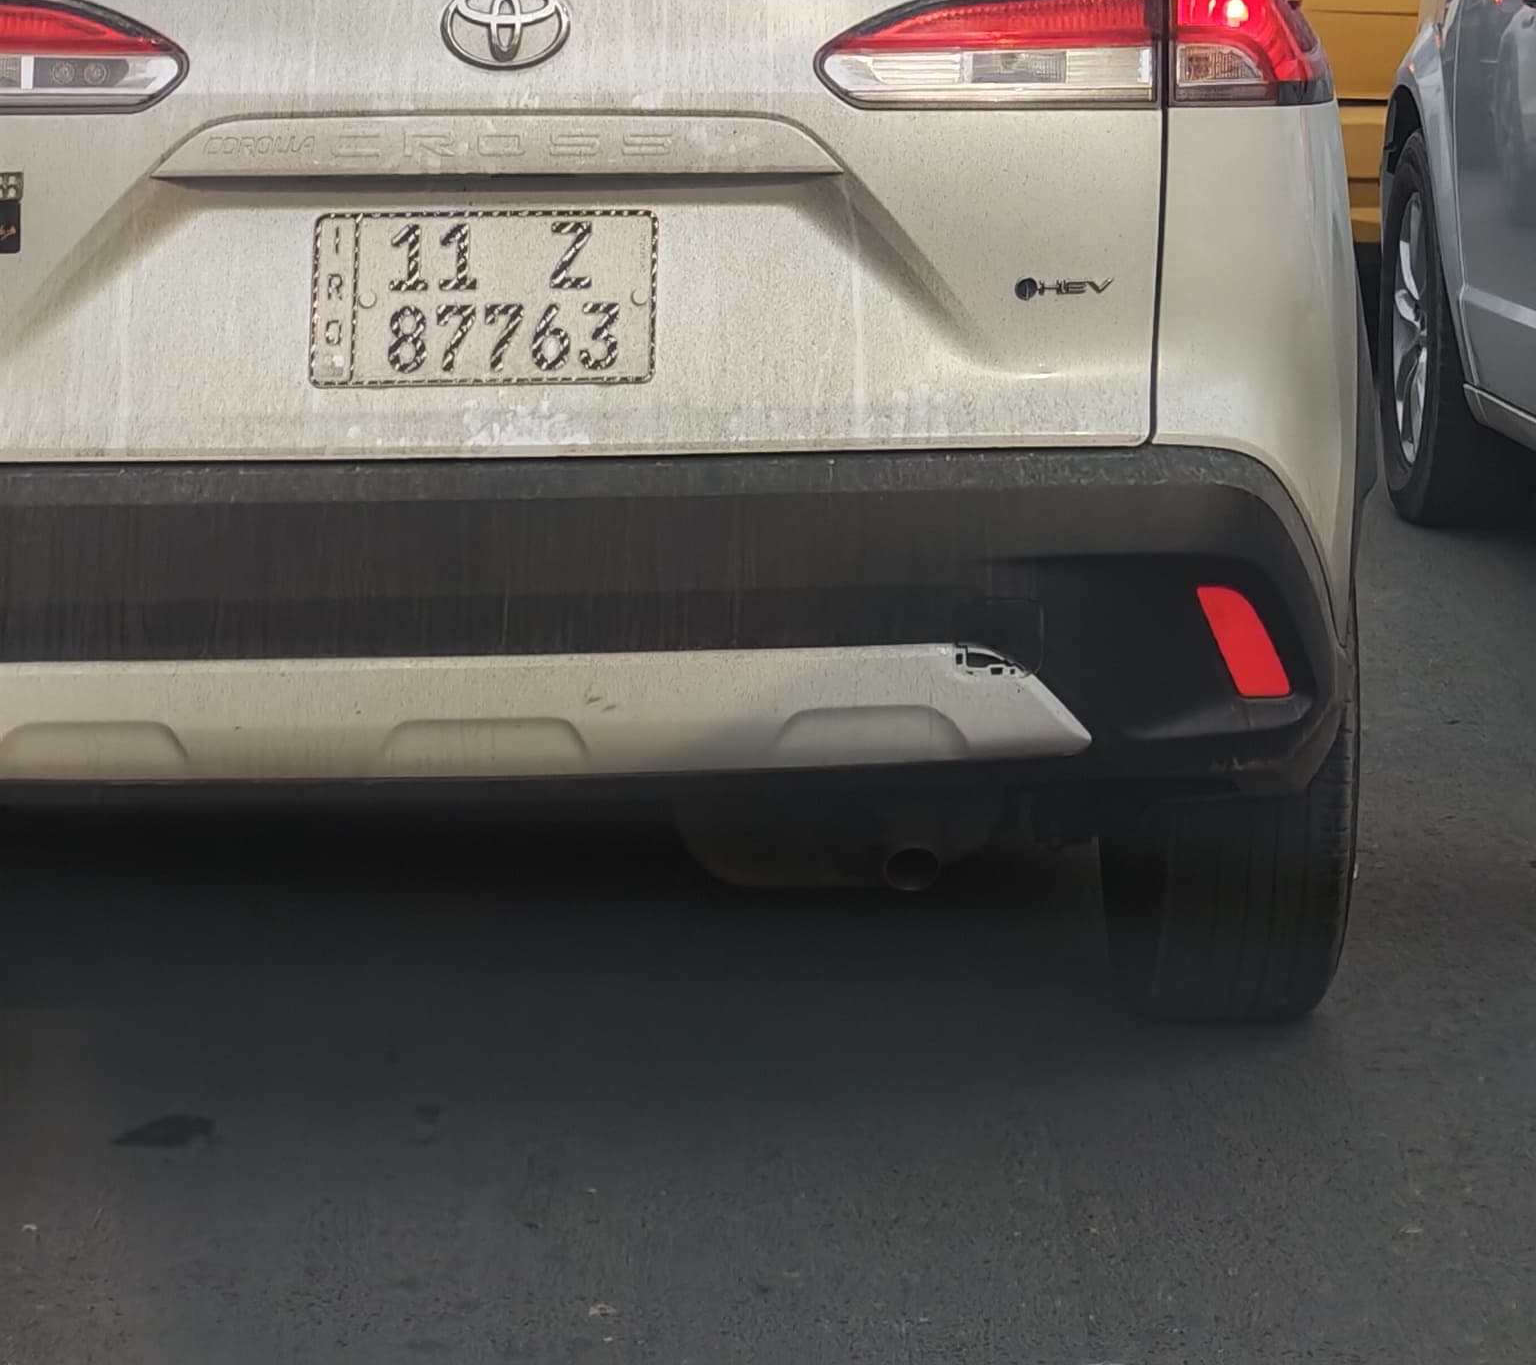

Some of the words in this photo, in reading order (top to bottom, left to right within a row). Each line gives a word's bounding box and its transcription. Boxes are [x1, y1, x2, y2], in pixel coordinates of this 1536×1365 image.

[203, 135, 316, 157] COROLLA
[330, 132, 674, 158] CROSS
[389, 224, 478, 292] 11
[551, 221, 593, 289] Z
[387, 302, 620, 374] 87763
